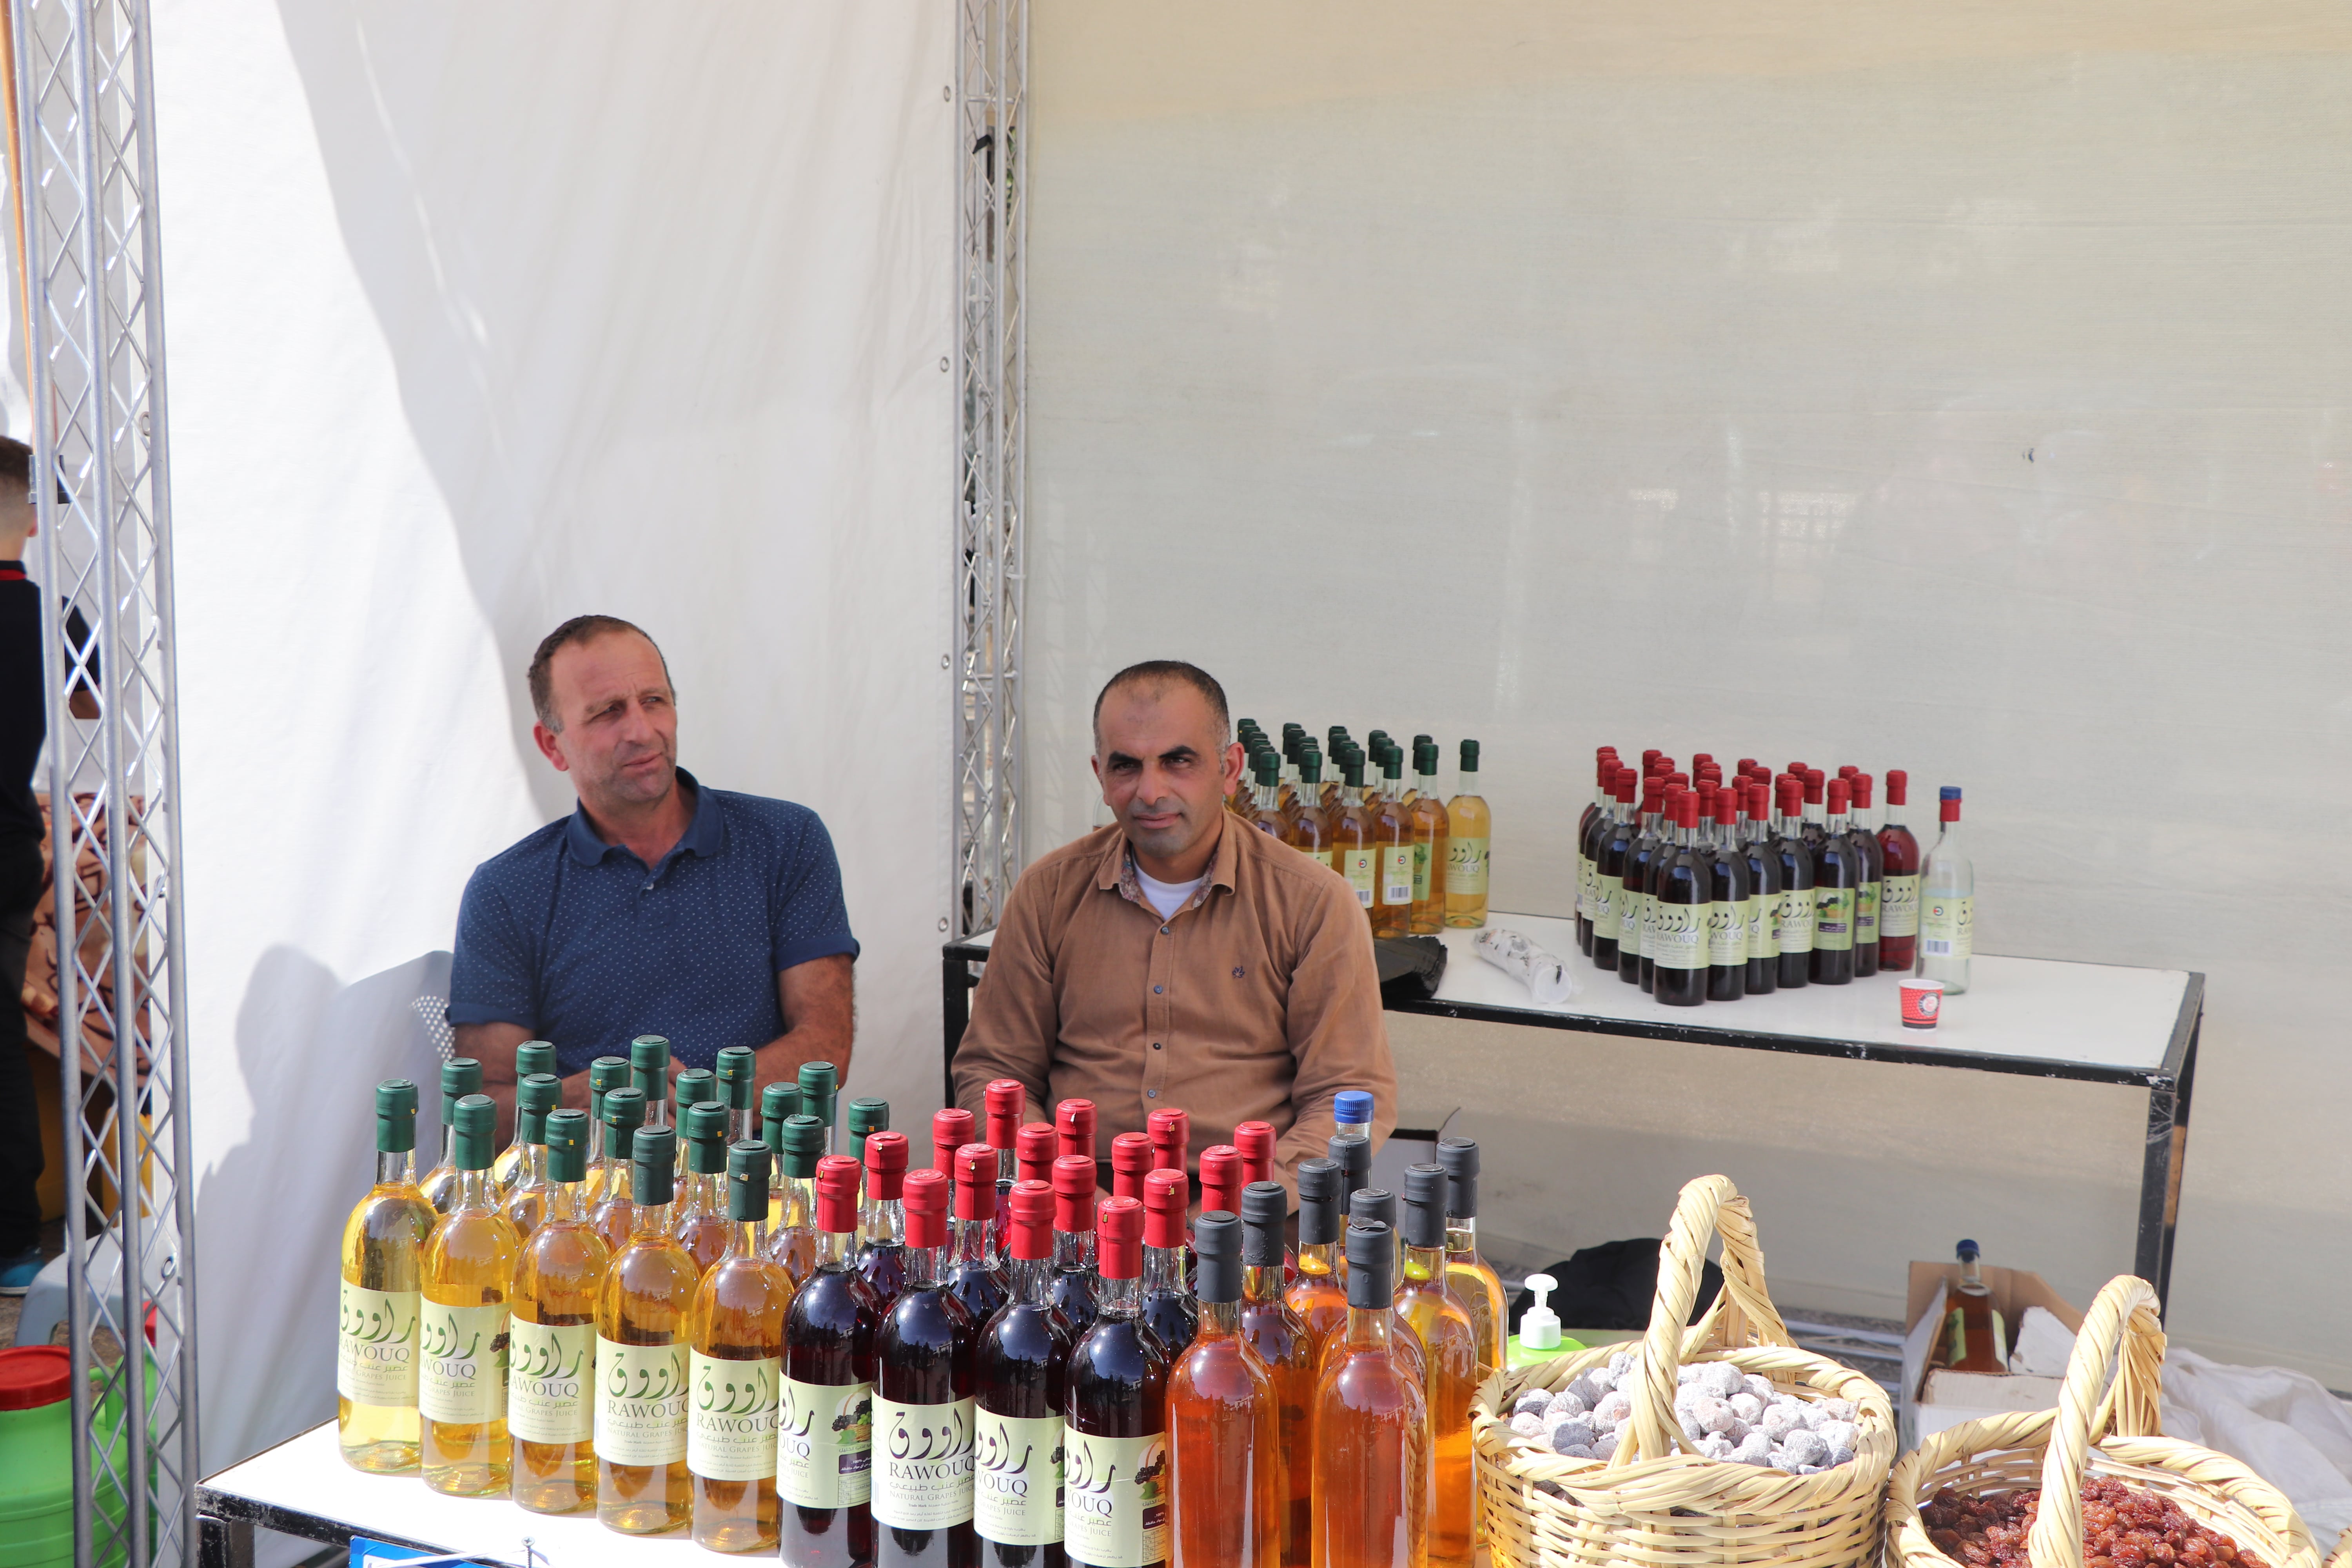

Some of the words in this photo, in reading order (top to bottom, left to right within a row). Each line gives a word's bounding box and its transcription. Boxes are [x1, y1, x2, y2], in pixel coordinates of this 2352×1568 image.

[1449, 841, 1481, 864] راوو
[1710, 905, 1744, 930] راوو
[420, 1313, 481, 1359] راوو
[356, 1369, 383, 1380] GRAPES
[421, 1354, 476, 1380] AWOUQ
[526, 1406, 552, 1416] GRAPES
[607, 1427, 640, 1437] NATURAL
[642, 1430, 672, 1438] GRAPES
[975, 1421, 1033, 1474] راوو
[791, 1468, 809, 1478] JUICE
[889, 1455, 975, 1480] RAWOUQ
[1065, 1439, 1116, 1494] راوو
[889, 1491, 925, 1501] NATURAL
[927, 1490, 956, 1501] GRAPES
[1003, 1507, 1025, 1516] JUICE
[1090, 1527, 1111, 1537] JUICE
